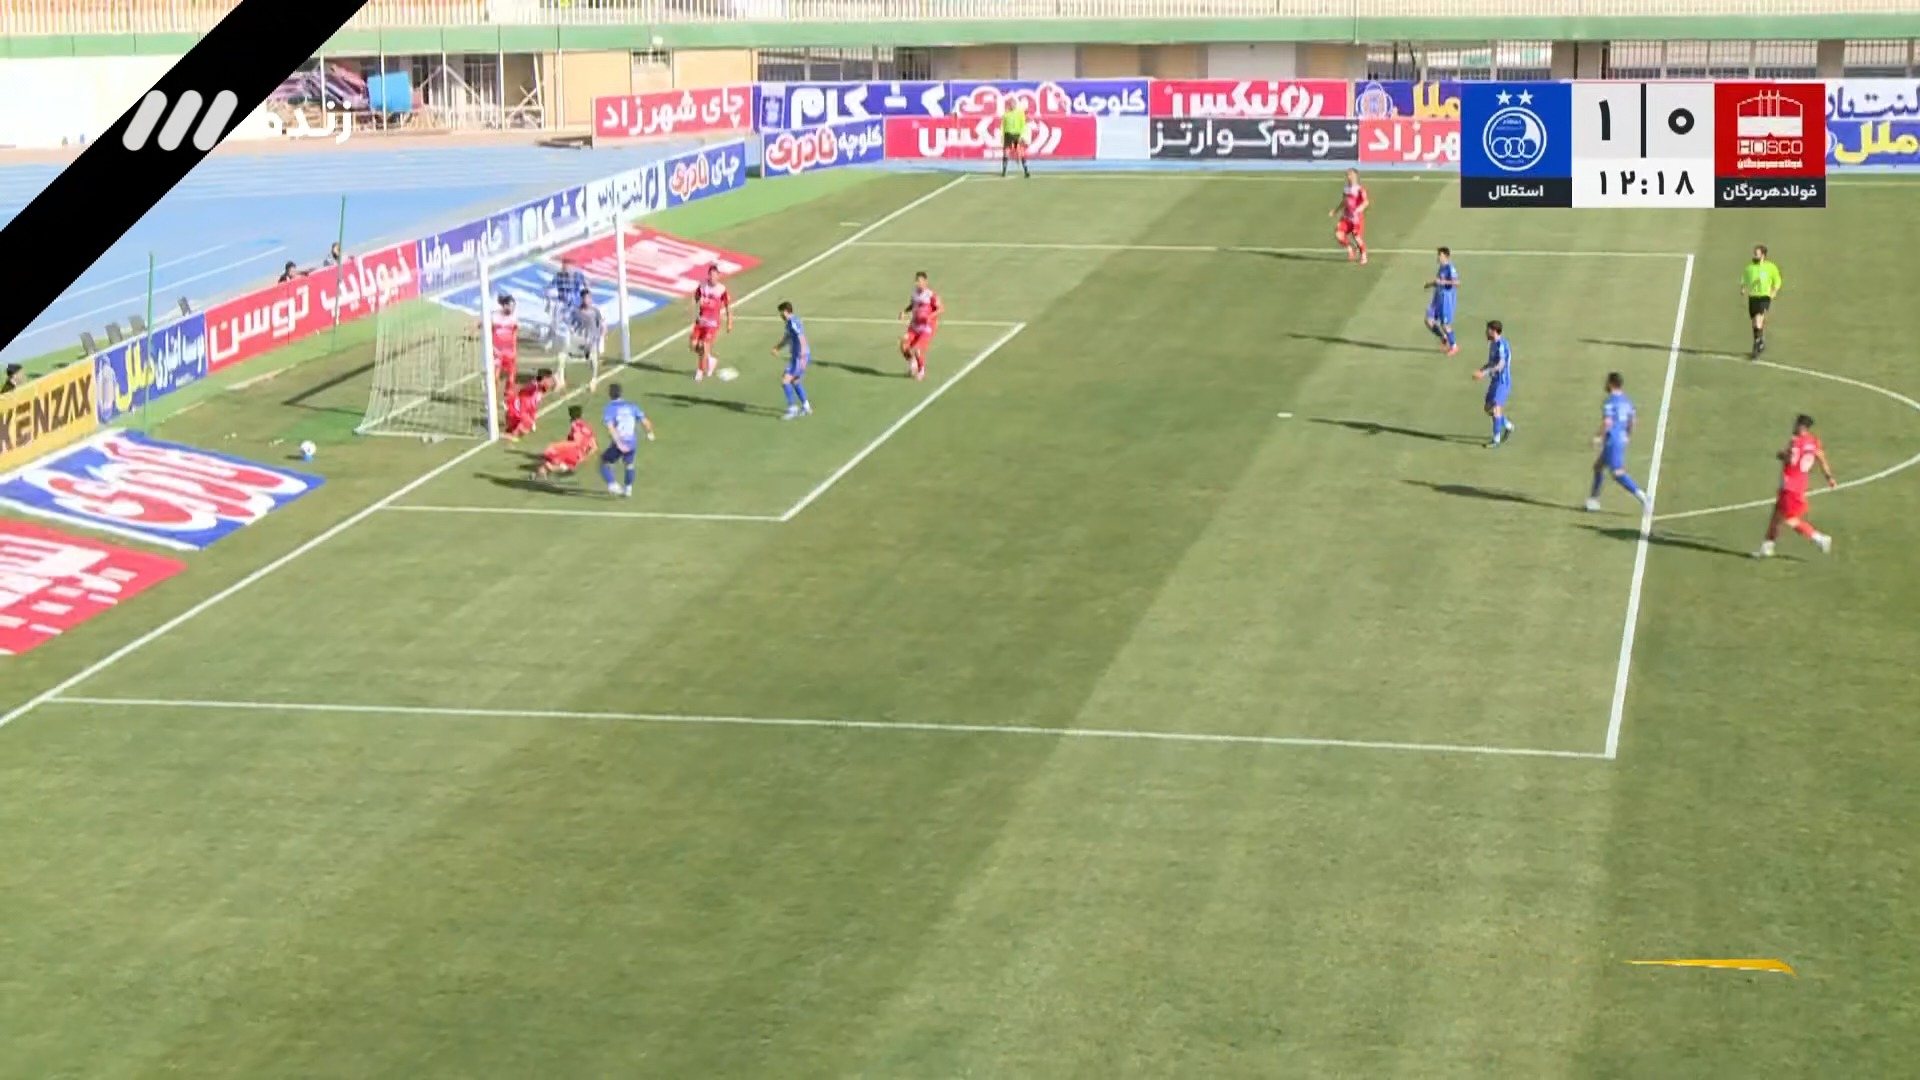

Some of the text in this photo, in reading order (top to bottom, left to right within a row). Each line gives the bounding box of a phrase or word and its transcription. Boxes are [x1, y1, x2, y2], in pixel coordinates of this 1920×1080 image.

[602, 88, 744, 136] چای شهرزاد
[766, 125, 882, 174] کلوچه نادری
[918, 116, 1062, 157] رویکس
[1150, 119, 1358, 157] توتم کوارتز
[1368, 120, 1460, 161] هرزاد
[1834, 120, 1919, 164] ملل
[711, 152, 740, 189] چای
[208, 285, 310, 364] توسن
[0, 374, 91, 454] KENZAX
